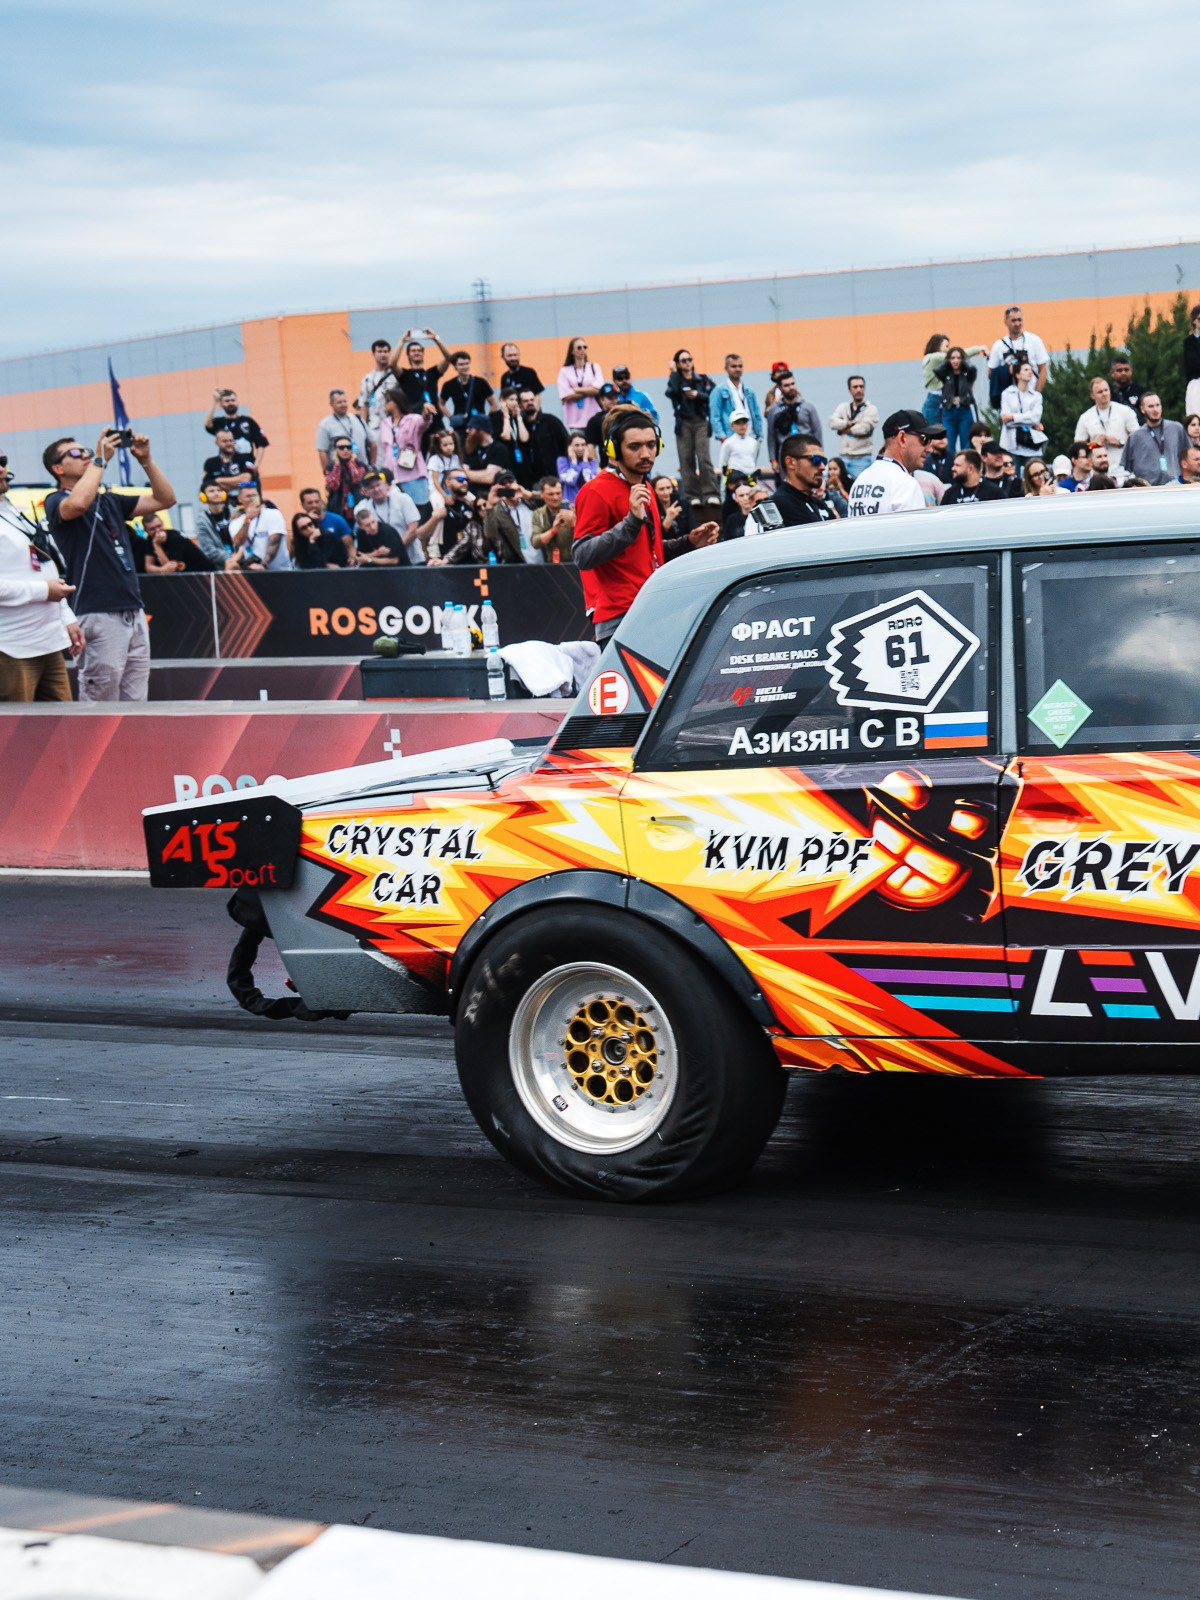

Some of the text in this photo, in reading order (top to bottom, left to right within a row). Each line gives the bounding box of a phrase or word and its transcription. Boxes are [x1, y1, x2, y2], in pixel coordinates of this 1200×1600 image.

[731, 616, 816, 642] ФРАСТ
[888, 616, 923, 631] RDRC
[730, 648, 819, 665] DISK BRAKE PADS
[886, 631, 930, 669] 61
[600, 676, 618, 715] E
[754, 691, 797, 703] TUNING
[756, 686, 784, 695] HELL
[728, 717, 921, 756] Азизян С В
[161, 821, 241, 863] ATS
[327, 823, 484, 861] CRYSTAL
[705, 831, 873, 874] KVM PPF
[203, 856, 278, 888] Sport
[372, 872, 442, 905] CAR
